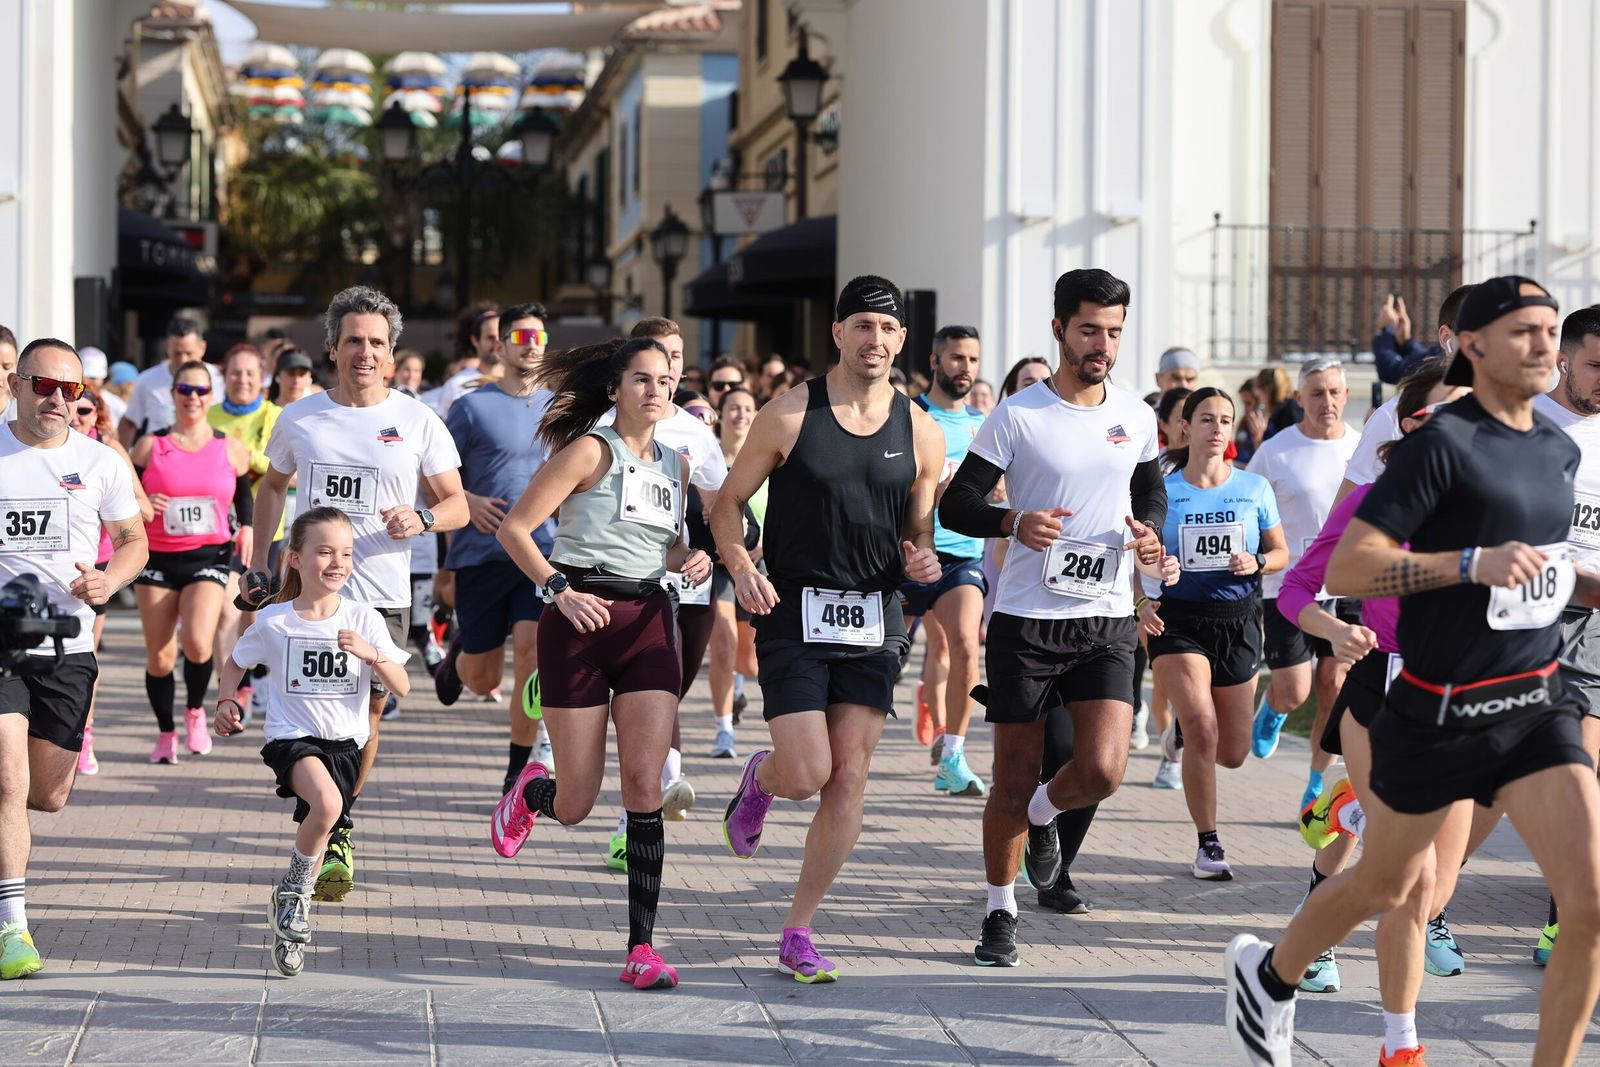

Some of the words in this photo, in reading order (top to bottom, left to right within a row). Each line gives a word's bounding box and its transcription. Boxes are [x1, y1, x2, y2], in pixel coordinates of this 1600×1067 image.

[325, 475, 361, 500] 501
[640, 480, 672, 512] 408
[5, 510, 51, 537] 357
[180, 506, 202, 522] 119
[1185, 511, 1235, 524] FRESO
[1573, 503, 1600, 531] 123
[1195, 535, 1232, 556] 494
[1061, 552, 1106, 582] 284
[821, 604, 865, 628] 488
[302, 650, 348, 678] 503
[1451, 688, 1546, 717] WONG
